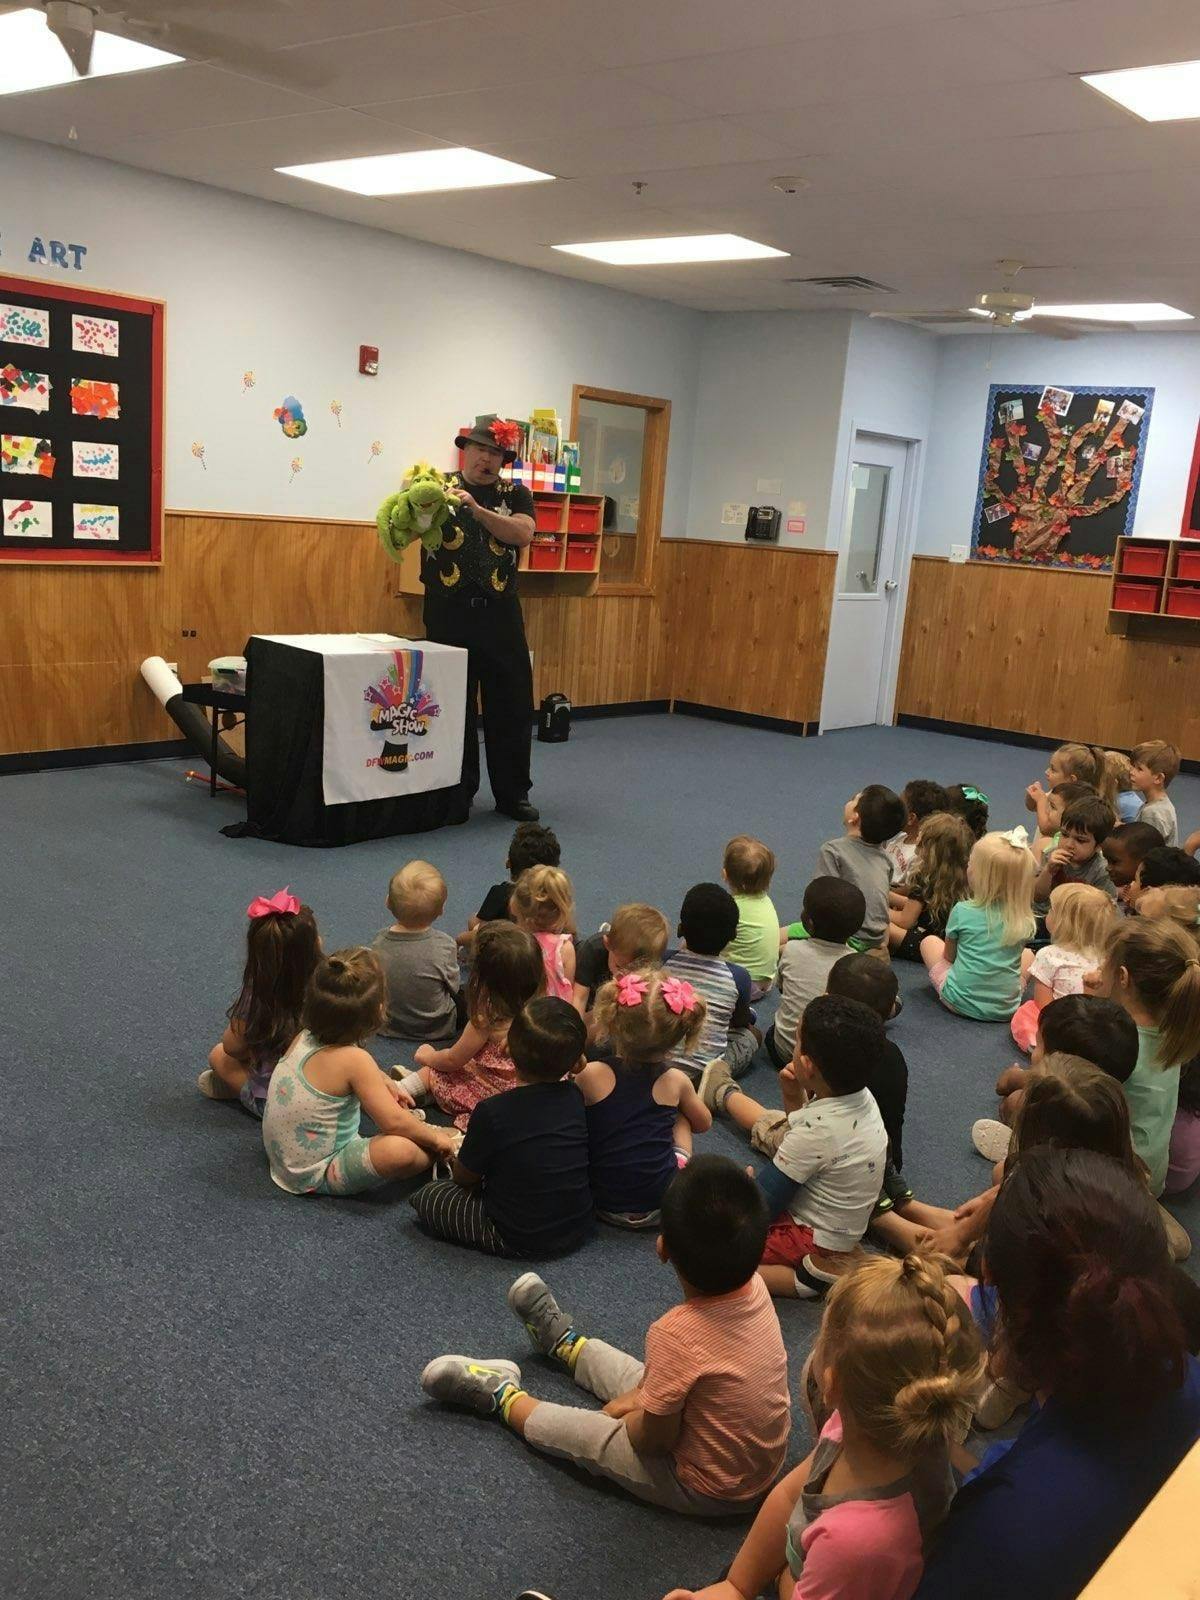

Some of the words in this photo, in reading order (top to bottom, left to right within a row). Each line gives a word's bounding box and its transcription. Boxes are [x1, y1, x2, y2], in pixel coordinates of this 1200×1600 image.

[28, 237, 87, 270] ART
[379, 703, 418, 723] MAGIC
[391, 719, 425, 736] SHOW
